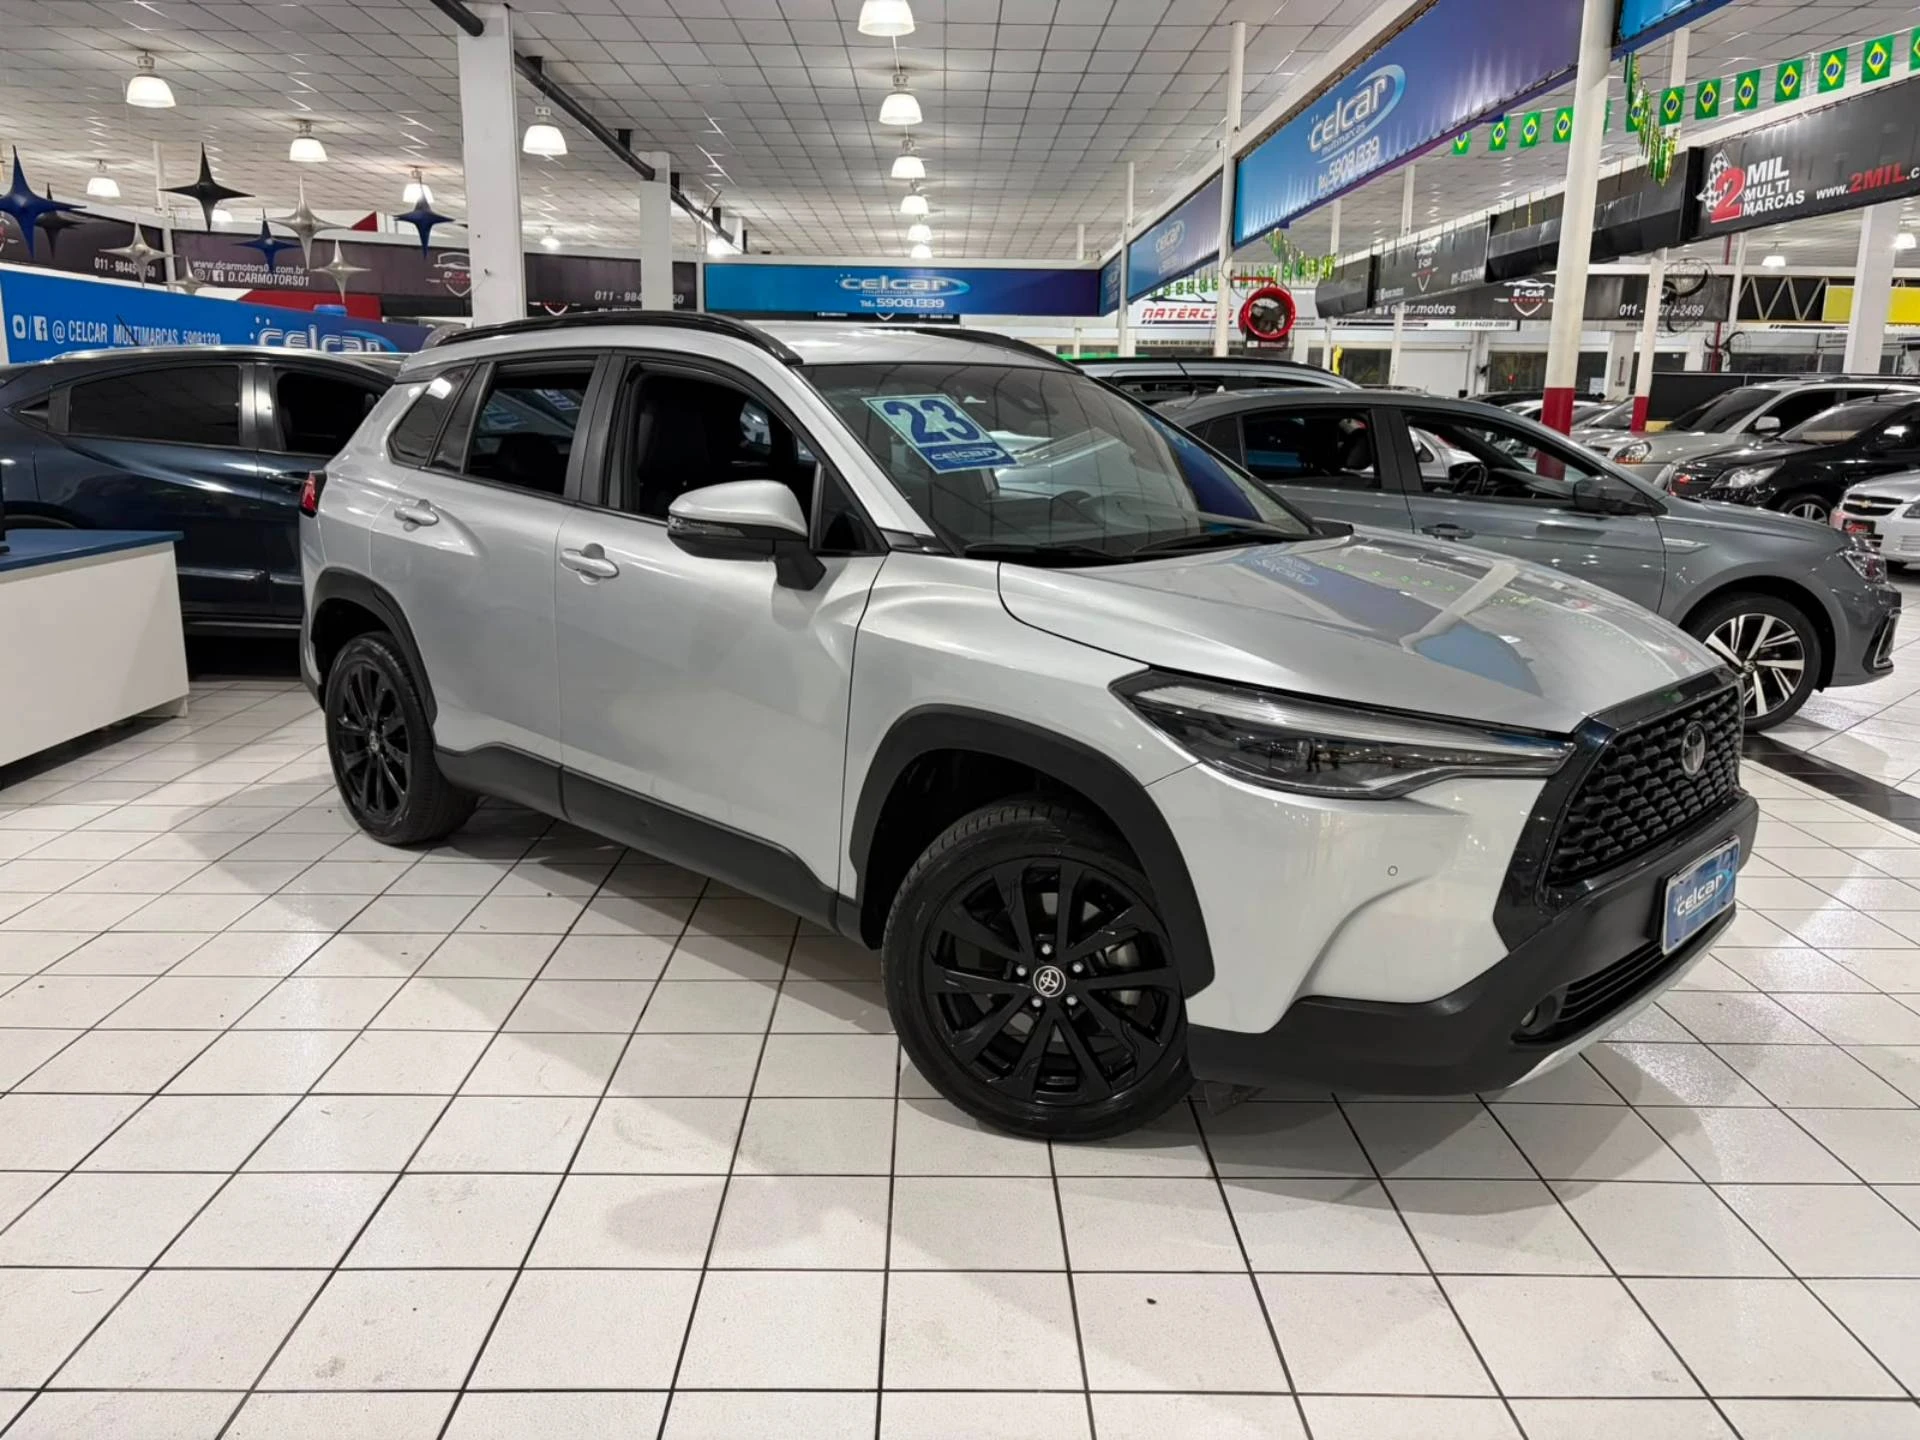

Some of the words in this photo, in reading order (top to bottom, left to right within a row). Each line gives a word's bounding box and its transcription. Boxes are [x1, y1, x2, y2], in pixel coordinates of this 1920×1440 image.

[1310, 78, 1386, 153] celcar
[1745, 156, 1789, 187] MIL
[1710, 166, 1746, 223] 2
[1744, 178, 1790, 201] MULTI
[1742, 190, 1806, 217] MARCAS
[193, 260, 305, 275] www.dcarmotors0.com.br
[228, 271, 310, 286] D.CARMOTORS01
[839, 274, 948, 291] celcar
[1619, 303, 1638, 317] 011
[67, 319, 108, 344] CELCAR
[883, 399, 980, 442] 23
[1676, 873, 1723, 917] celcar
